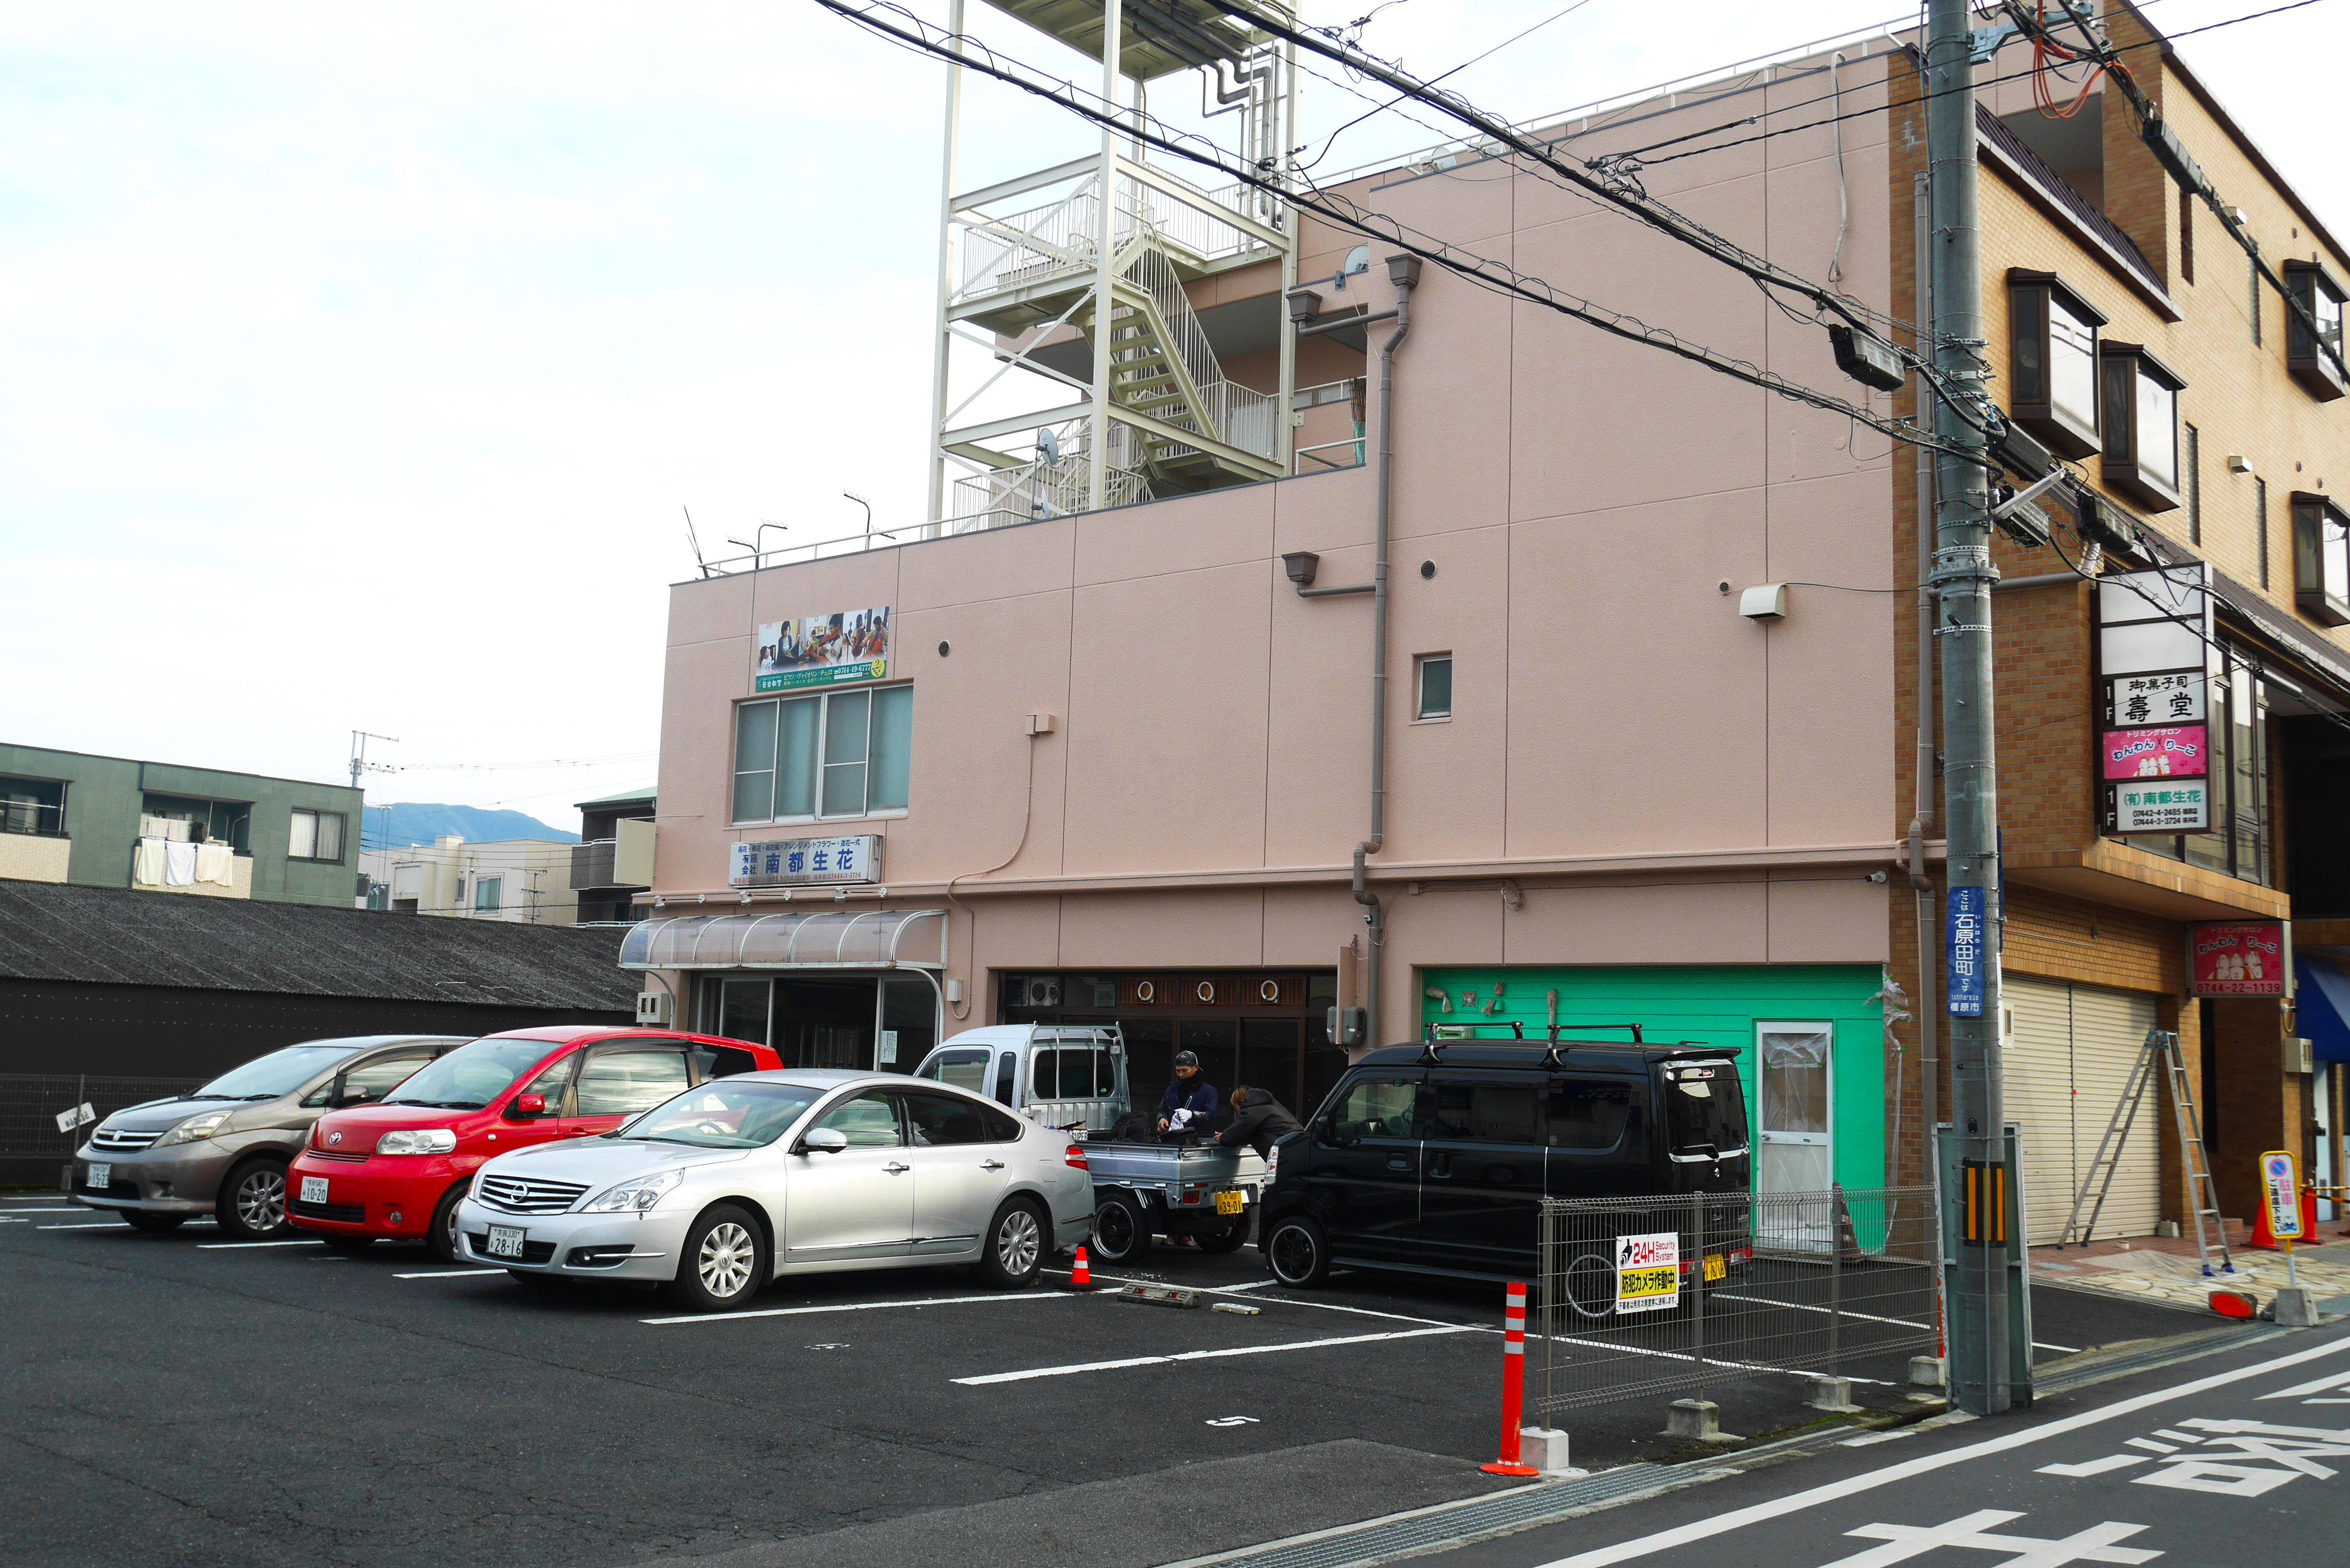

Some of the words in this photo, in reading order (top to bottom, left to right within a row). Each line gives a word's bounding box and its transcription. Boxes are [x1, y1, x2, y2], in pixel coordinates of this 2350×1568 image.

[2128, 676, 2188, 692] 御菓子司
[2127, 728, 2181, 738] トリミングサロン
[2133, 808, 2182, 818] 07442-4-2485
[2133, 817, 2181, 826] 07444-3-3724
[765, 848, 854, 874] 南都生花
[2196, 983, 2281, 993] 0744-22-1139
[2279, 1179, 2294, 1206] 駐車
[494, 1238, 523, 1255] 28-16
[1656, 1241, 1676, 1251] Security
[1633, 1241, 1655, 1265] 24H
[1656, 1252, 1674, 1263] System
[1621, 1269, 1676, 1295] 防犯カメラ作動中
